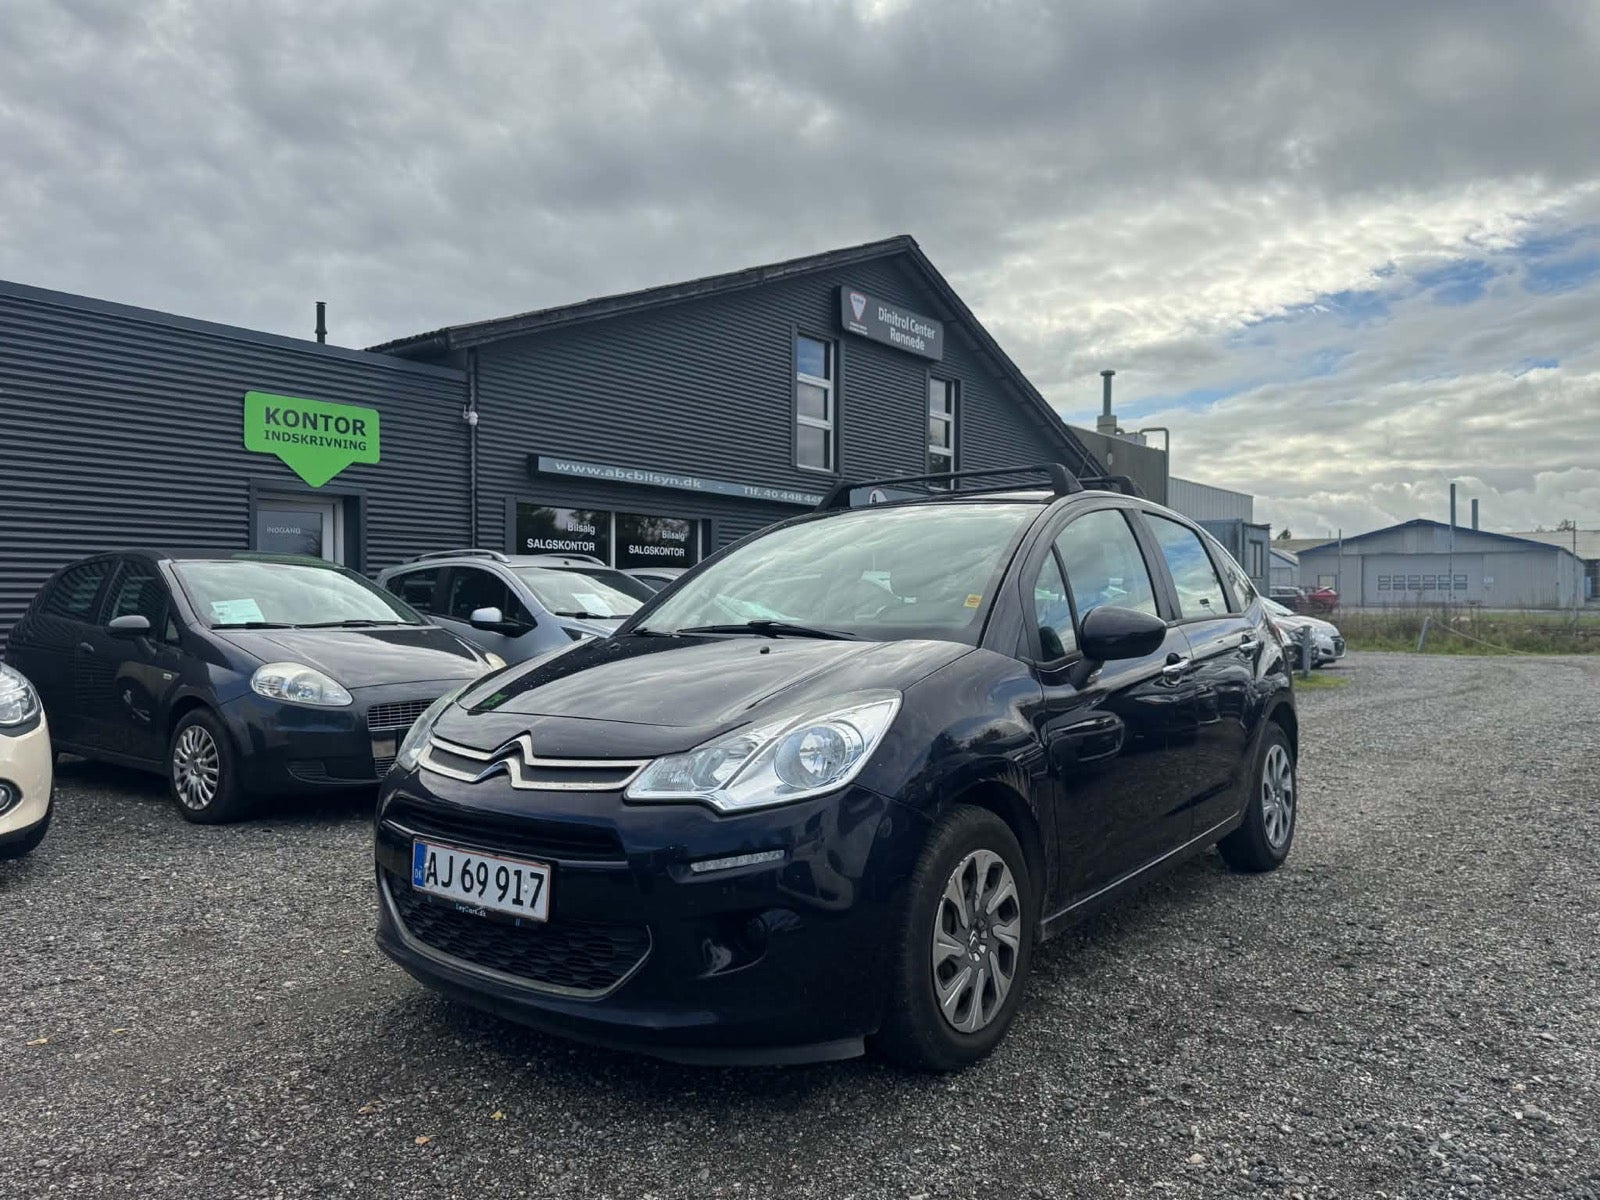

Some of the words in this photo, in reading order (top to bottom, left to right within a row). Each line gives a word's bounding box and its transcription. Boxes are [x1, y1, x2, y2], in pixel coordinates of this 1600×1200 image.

[878, 307, 909, 330] Dinitrol
[910, 319, 936, 339] Center
[264, 406, 366, 437] KONTOR
[264, 429, 367, 451] INDSKRIVNING
[555, 462, 701, 489] www.abcbilsyn.dk
[763, 489, 778, 498] 40
[567, 522, 596, 535] Bilsalg
[661, 530, 685, 542] Bilsalg
[526, 538, 596, 552] SALGSKONTOR
[628, 544, 685, 557] SALGSKONTOR
[425, 851, 454, 888] AJ
[460, 858, 489, 898] 69
[495, 865, 545, 909] 917
